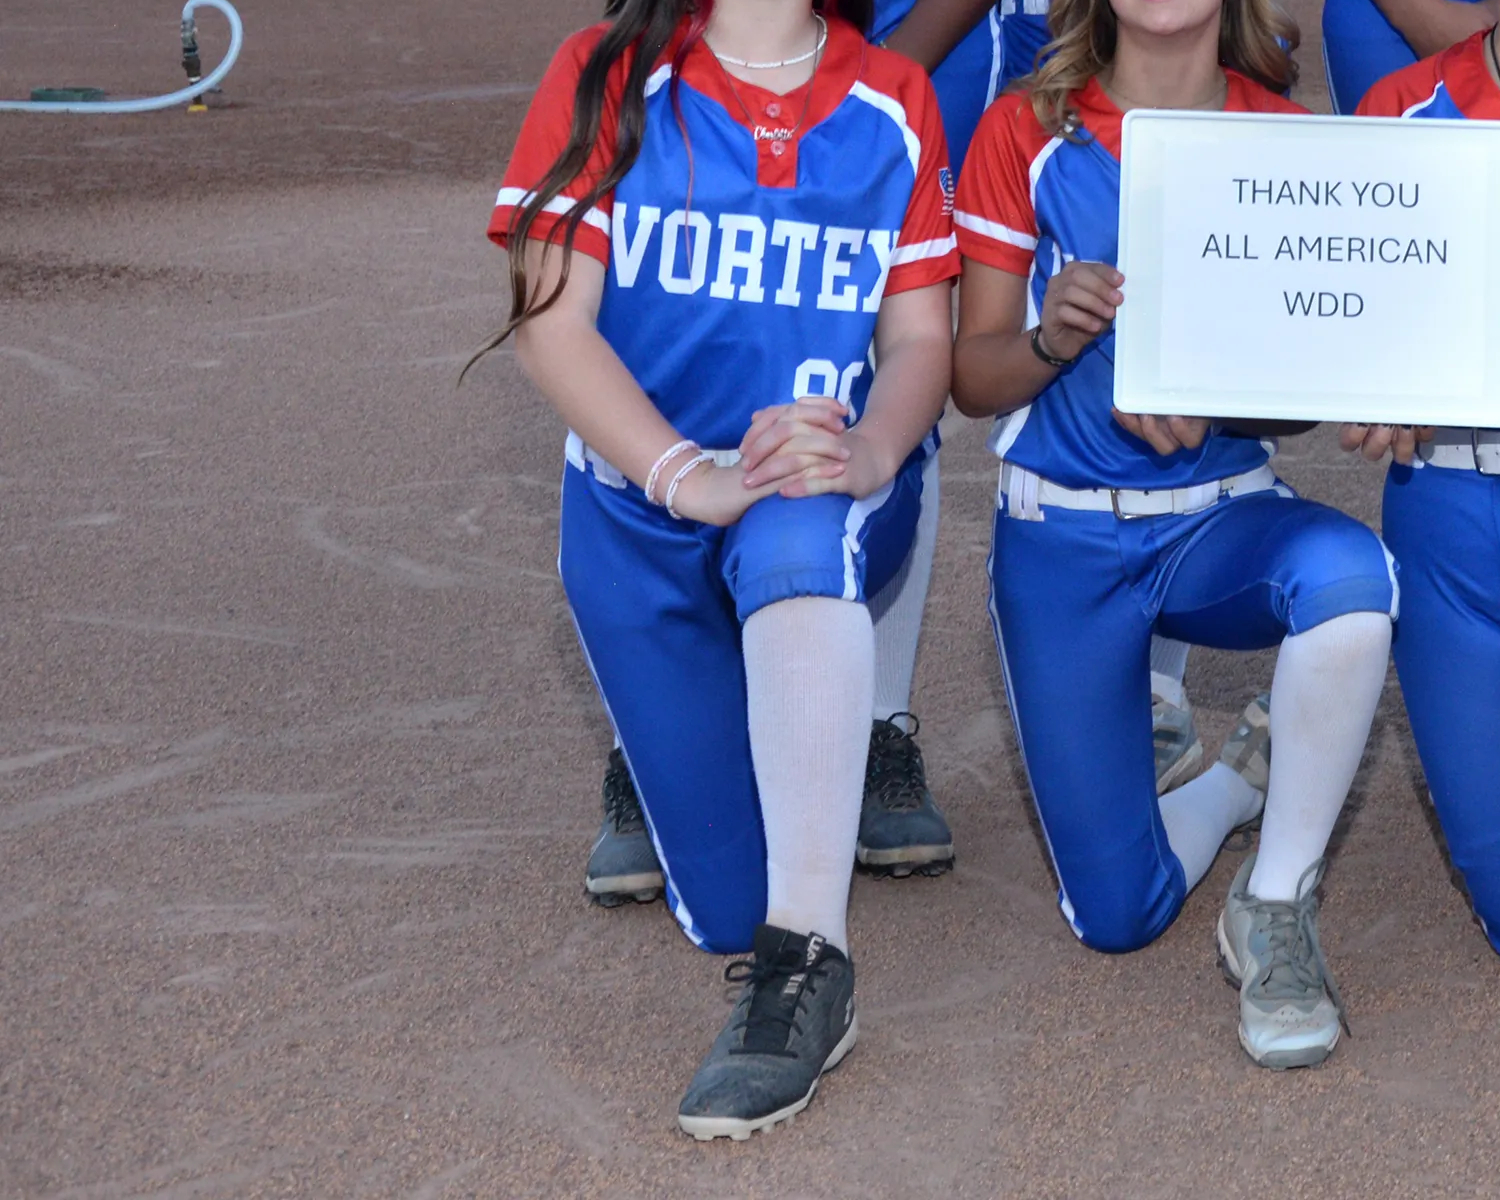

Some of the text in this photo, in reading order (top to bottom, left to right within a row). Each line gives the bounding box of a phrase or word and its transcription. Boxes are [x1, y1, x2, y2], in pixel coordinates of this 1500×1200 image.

[1232, 178, 1420, 209] THANK YOU
[1201, 233, 1448, 265] ALL AMERICAN
[1283, 290, 1365, 318] WDD
